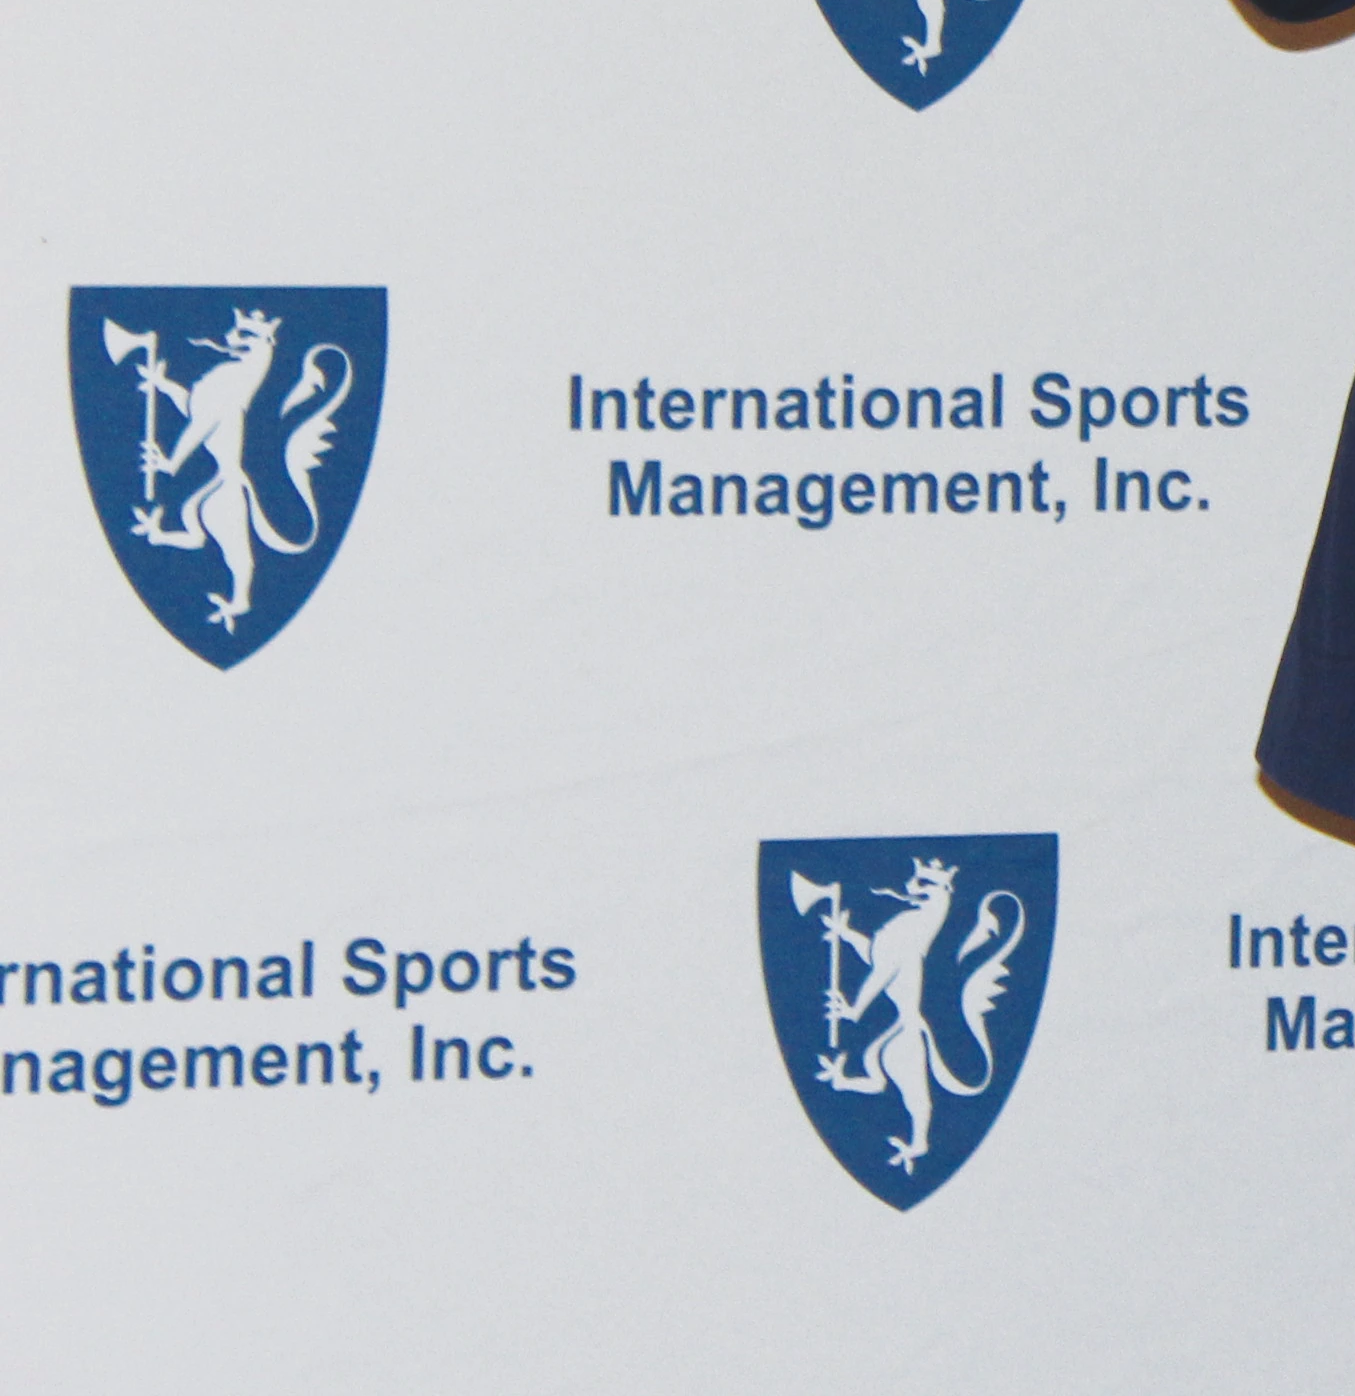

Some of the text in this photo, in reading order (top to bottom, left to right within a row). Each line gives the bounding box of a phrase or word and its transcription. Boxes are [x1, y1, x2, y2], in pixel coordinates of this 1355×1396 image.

[571, 371, 1250, 443] International Sports
[610, 456, 1209, 531] Management, Inc.
[0, 936, 577, 1010] rnational Sports
[3, 1024, 533, 1107] nagement, Inc.
